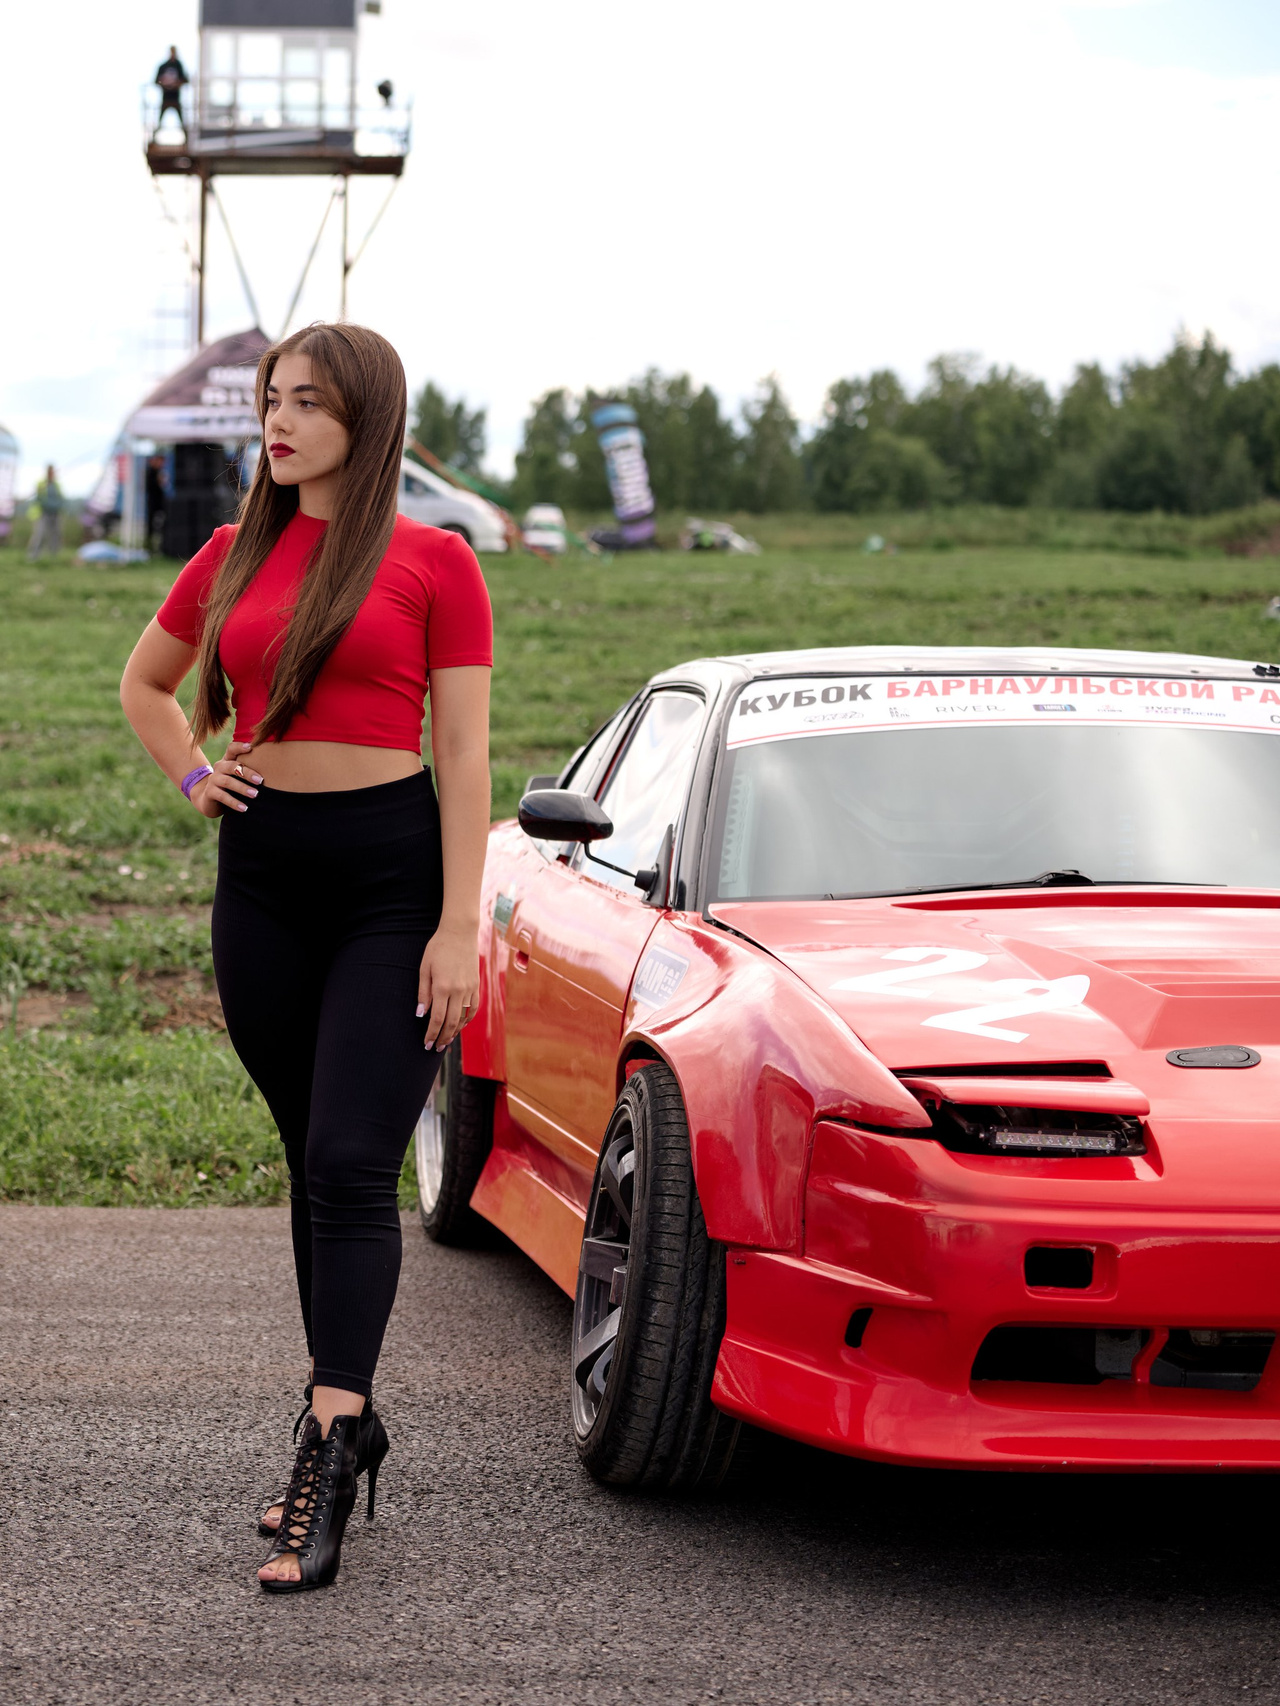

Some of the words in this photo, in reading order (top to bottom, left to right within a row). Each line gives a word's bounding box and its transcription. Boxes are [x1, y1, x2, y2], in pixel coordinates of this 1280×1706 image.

[738, 682, 873, 717] КУБОК
[885, 676, 1215, 700] БАРНАУЛЬСКОЙ
[935, 704, 1006, 713] RIVER
